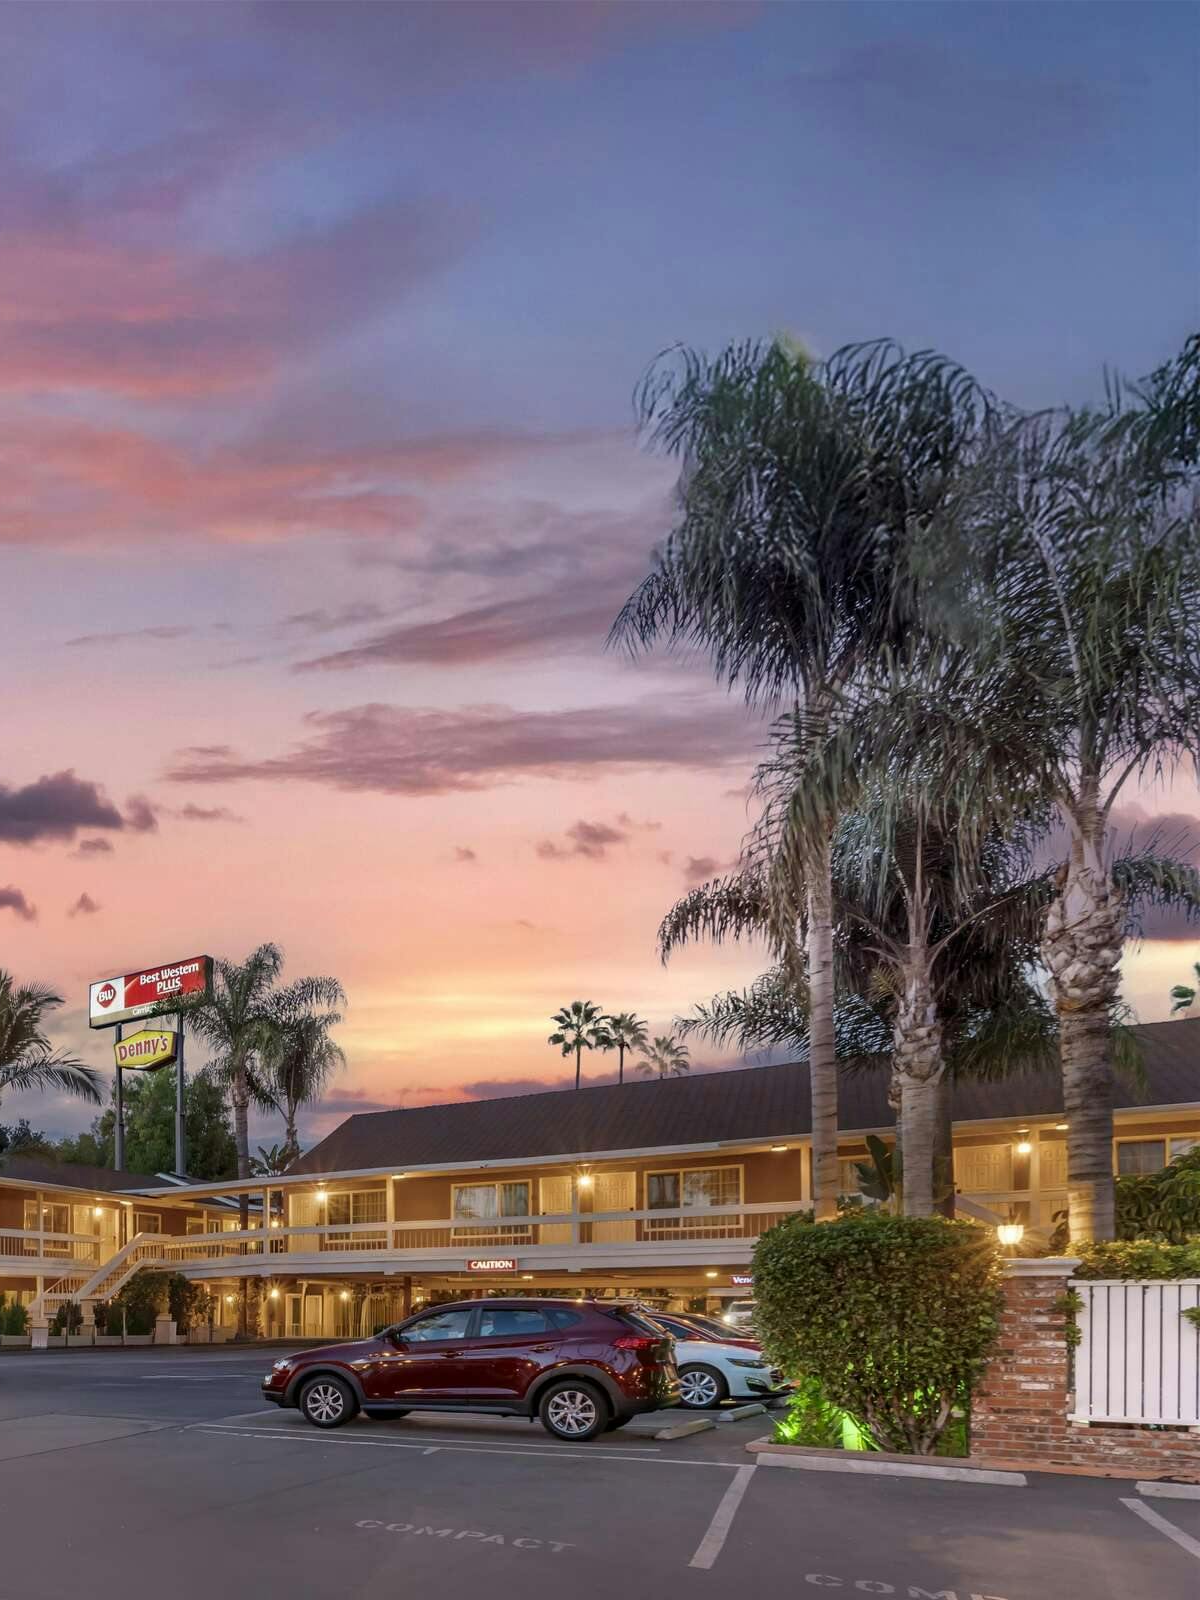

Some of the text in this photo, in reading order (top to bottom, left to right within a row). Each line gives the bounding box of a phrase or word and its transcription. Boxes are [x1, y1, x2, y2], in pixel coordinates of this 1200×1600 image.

[140, 962, 199, 985] Best Western
[156, 977, 181, 993] PLUS
[99, 989, 114, 1002] BW
[118, 1035, 168, 1061] Denny's
[471, 1260, 513, 1269] CAUTION
[355, 1519, 577, 1552] COMPACT
